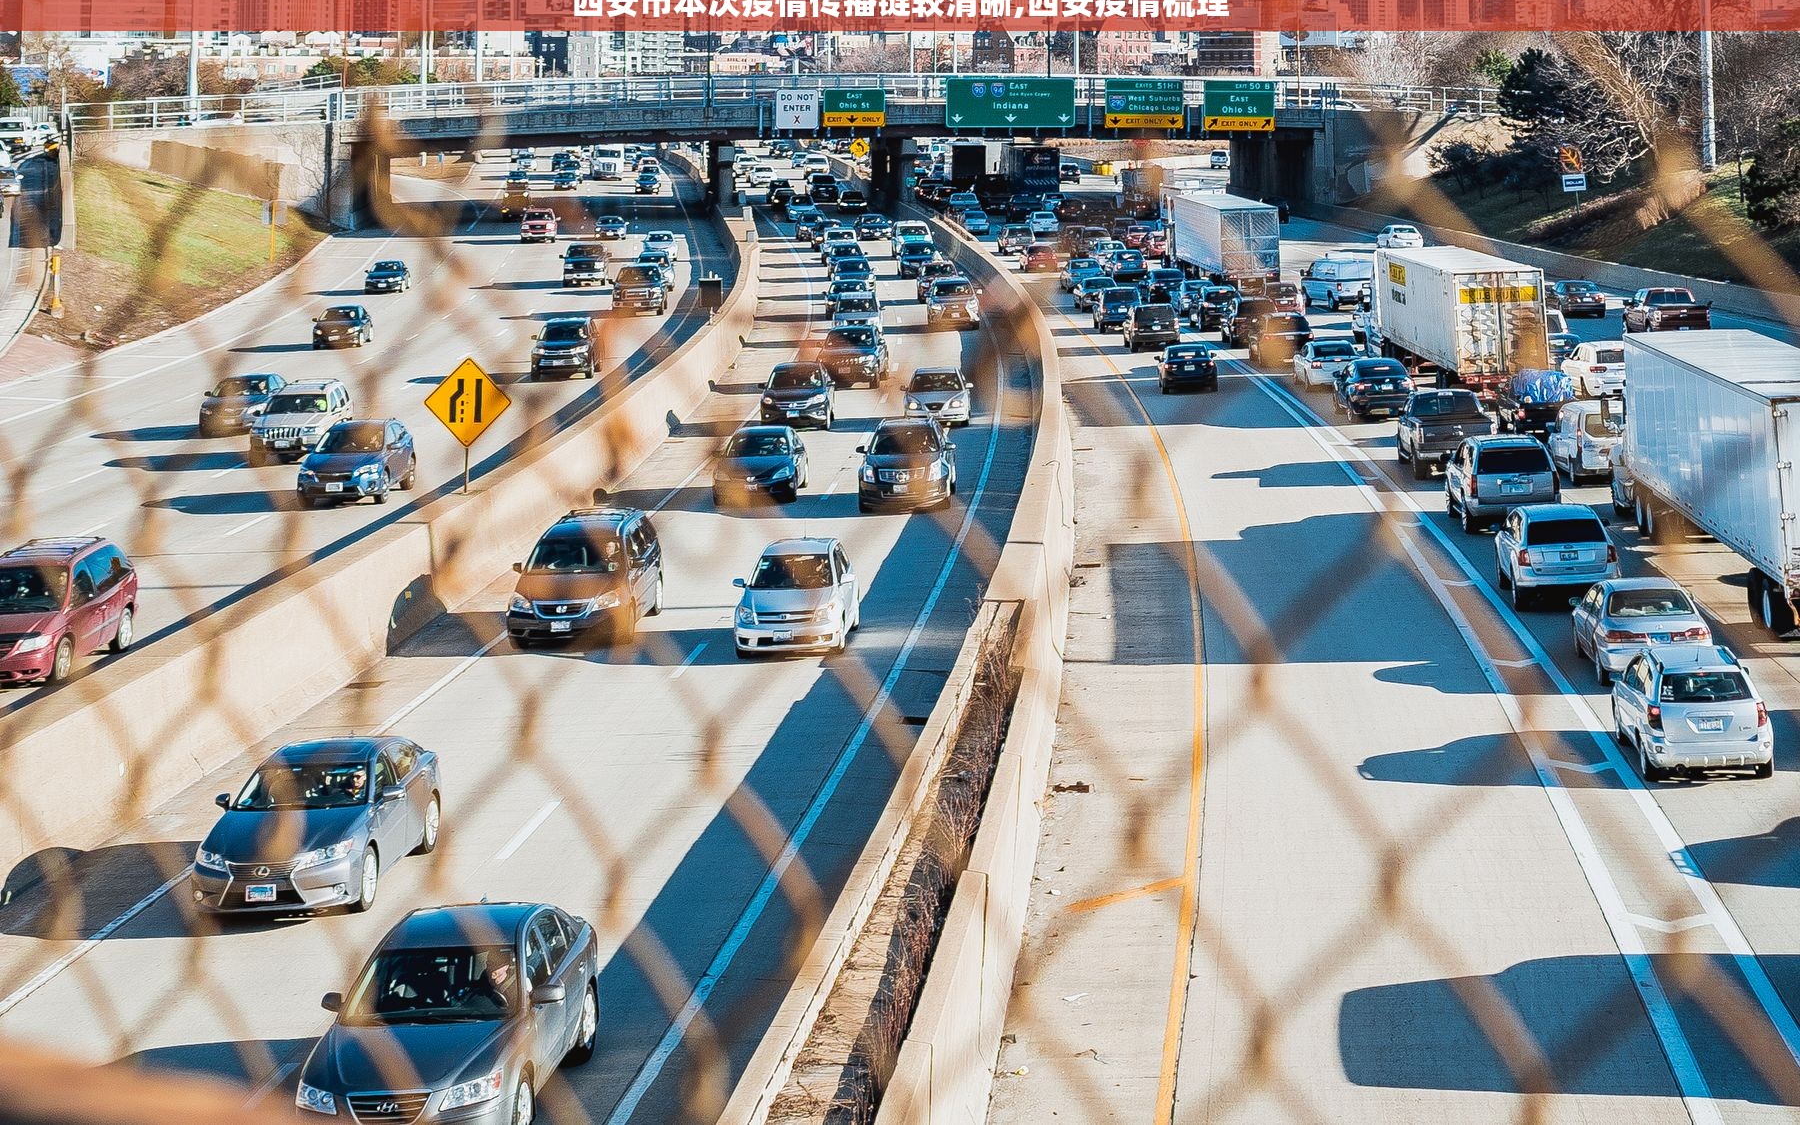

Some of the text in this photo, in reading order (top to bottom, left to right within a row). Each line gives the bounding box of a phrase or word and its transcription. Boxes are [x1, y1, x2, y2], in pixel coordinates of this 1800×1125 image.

[973, 82, 1028, 94] 90 94 EAST
[1249, 82, 1261, 90] 50
[780, 93, 814, 101] DO NOT
[993, 102, 1029, 110] Indiana
[1111, 99, 1124, 107] 290
[783, 104, 811, 112] ENTER
[1128, 104, 1180, 112] Chicago Loop
[1221, 106, 1258, 114] Ohio St
